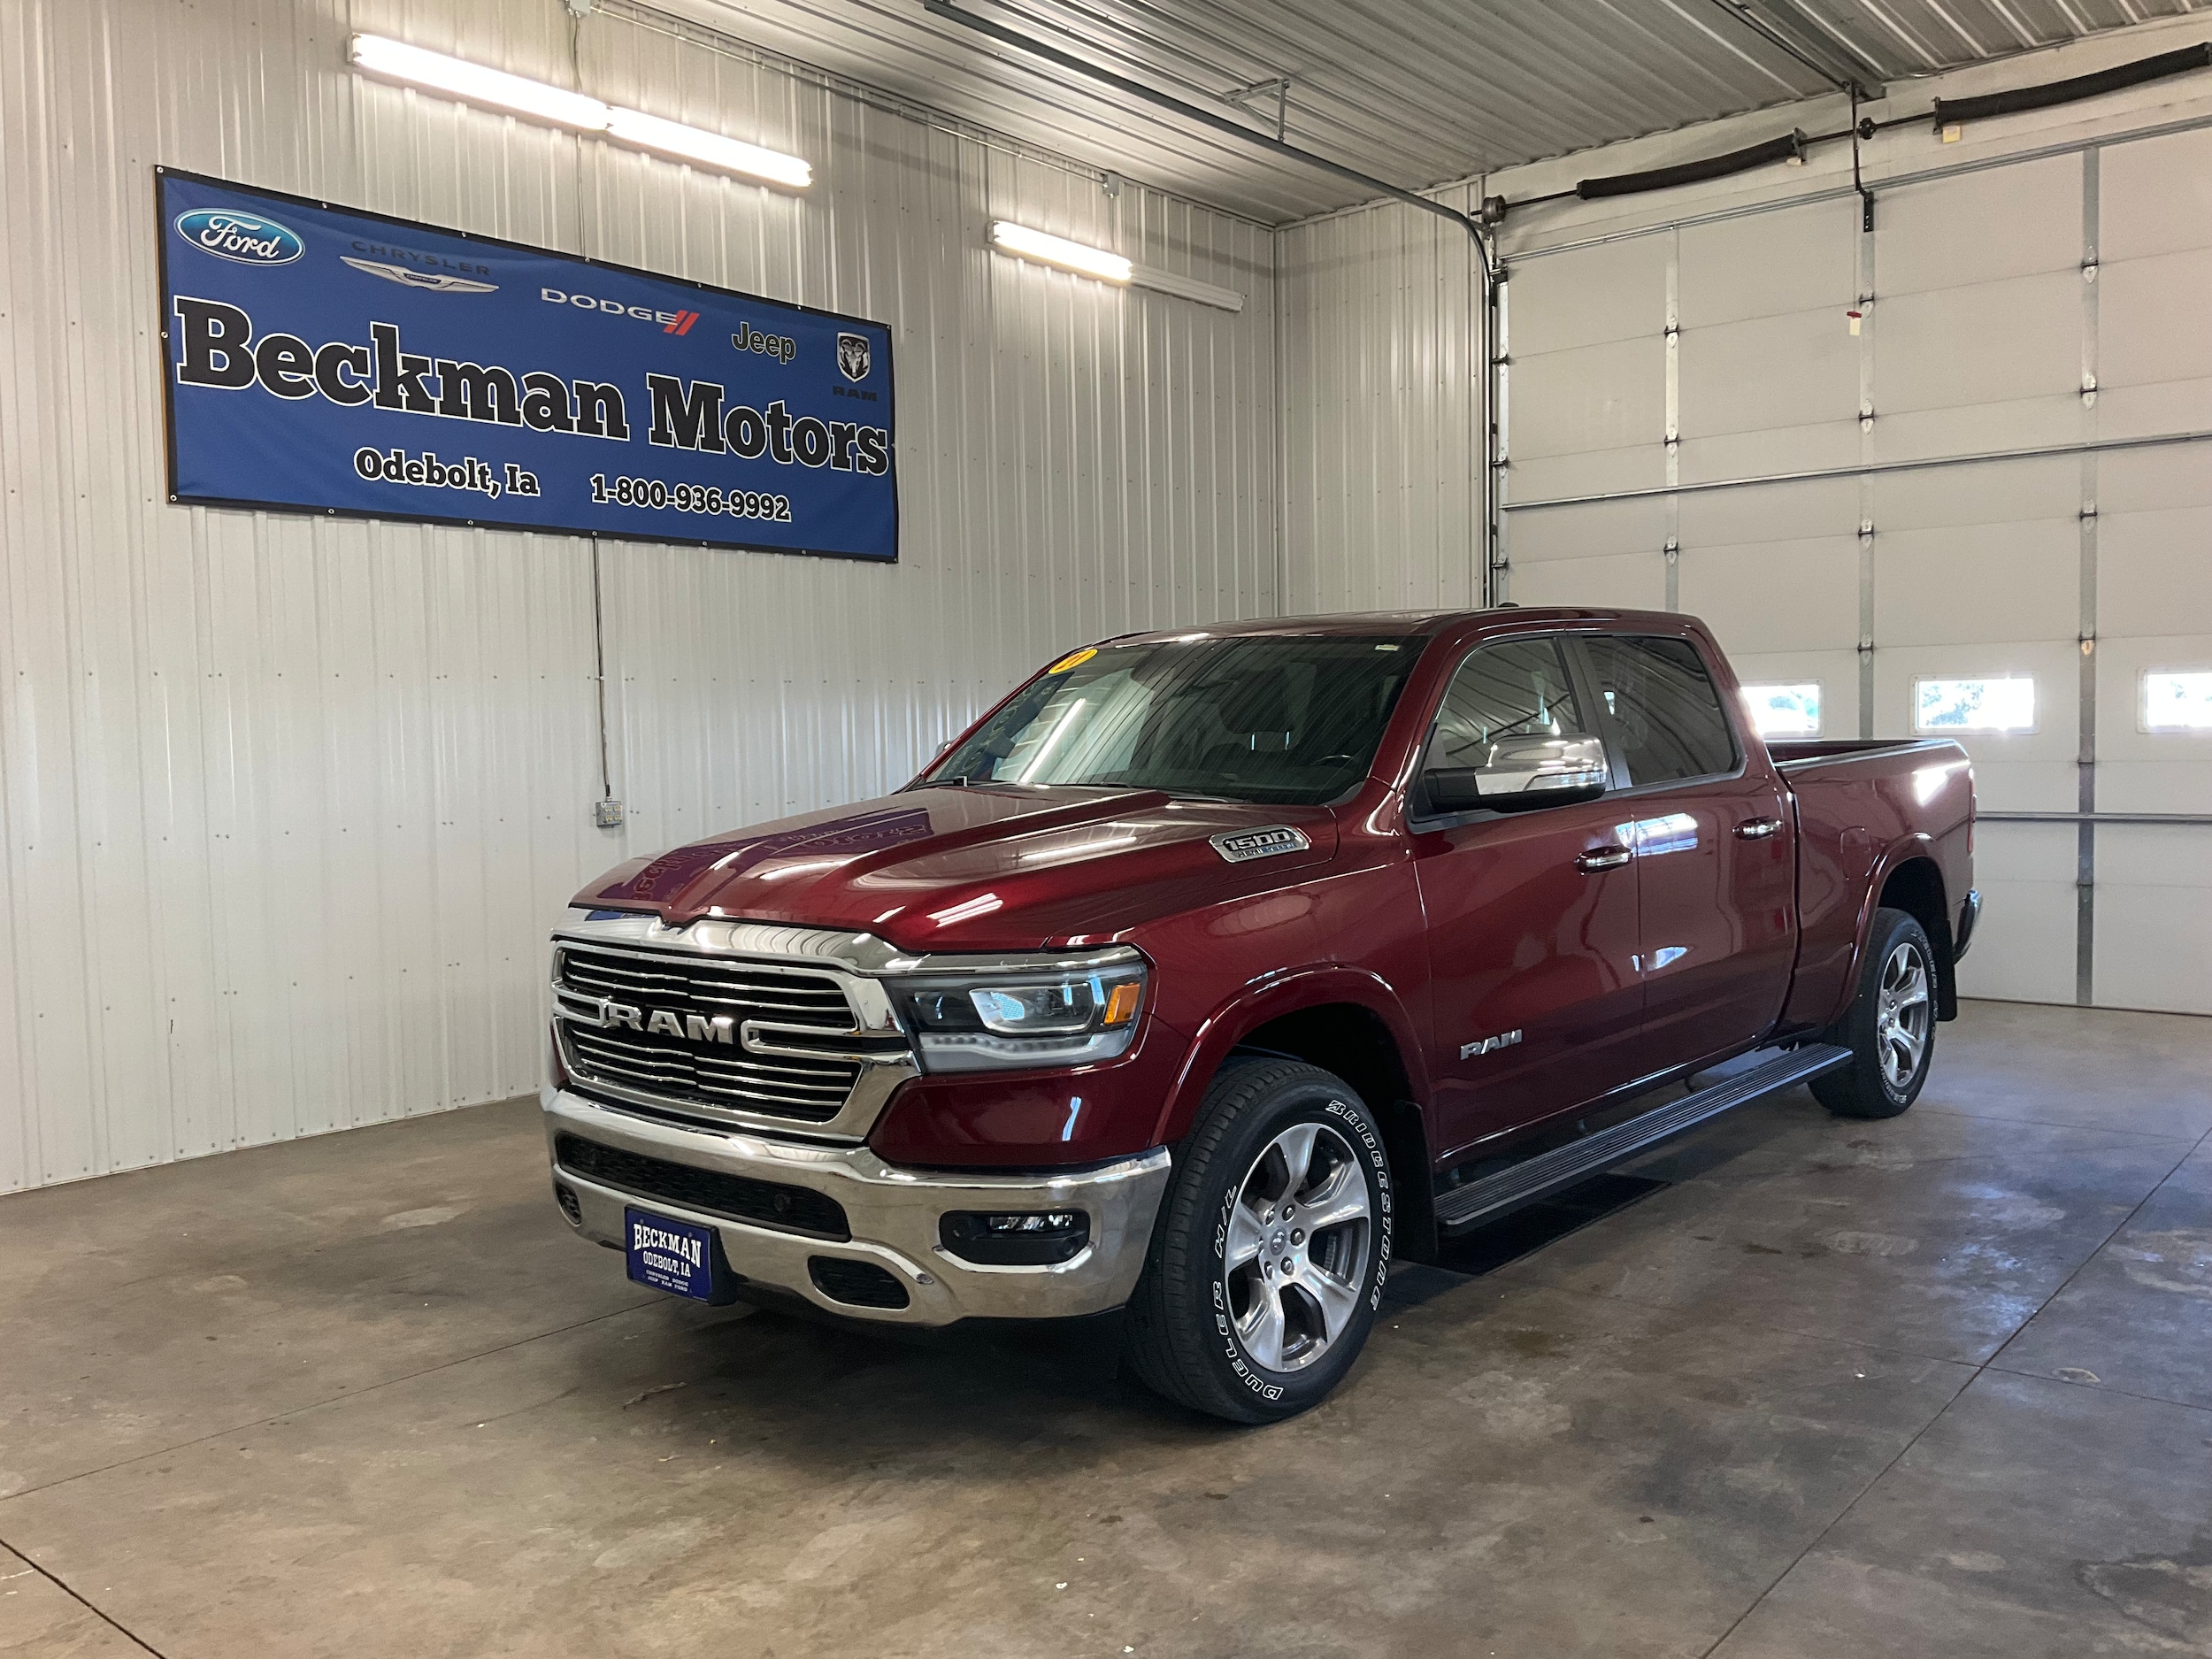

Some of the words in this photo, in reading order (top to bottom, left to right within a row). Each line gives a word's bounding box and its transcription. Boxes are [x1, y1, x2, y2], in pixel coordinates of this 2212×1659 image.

[200, 216, 281, 258] Ford
[351, 241, 489, 276] CHRYSLER
[541, 288, 678, 326] DODGE
[732, 321, 795, 365] Jeep
[173, 295, 630, 442] Beckman
[646, 373, 889, 476] Motors
[833, 385, 878, 402] RAM
[354, 447, 502, 500] Odebolt,
[504, 463, 541, 497] Ia
[589, 472, 792, 523] 1-800-936-9992
[1225, 831, 1292, 851] 1500
[607, 1002, 733, 1045] RAM
[1460, 1029, 1523, 1061] RAM
[1325, 1099, 1392, 1311] BRIDGESTONE
[634, 1223, 702, 1268] BECKMAN
[643, 1250, 680, 1276] ODEBOLT,
[680, 1262, 691, 1278] IA
[1213, 1280, 1284, 1400] DUELER
